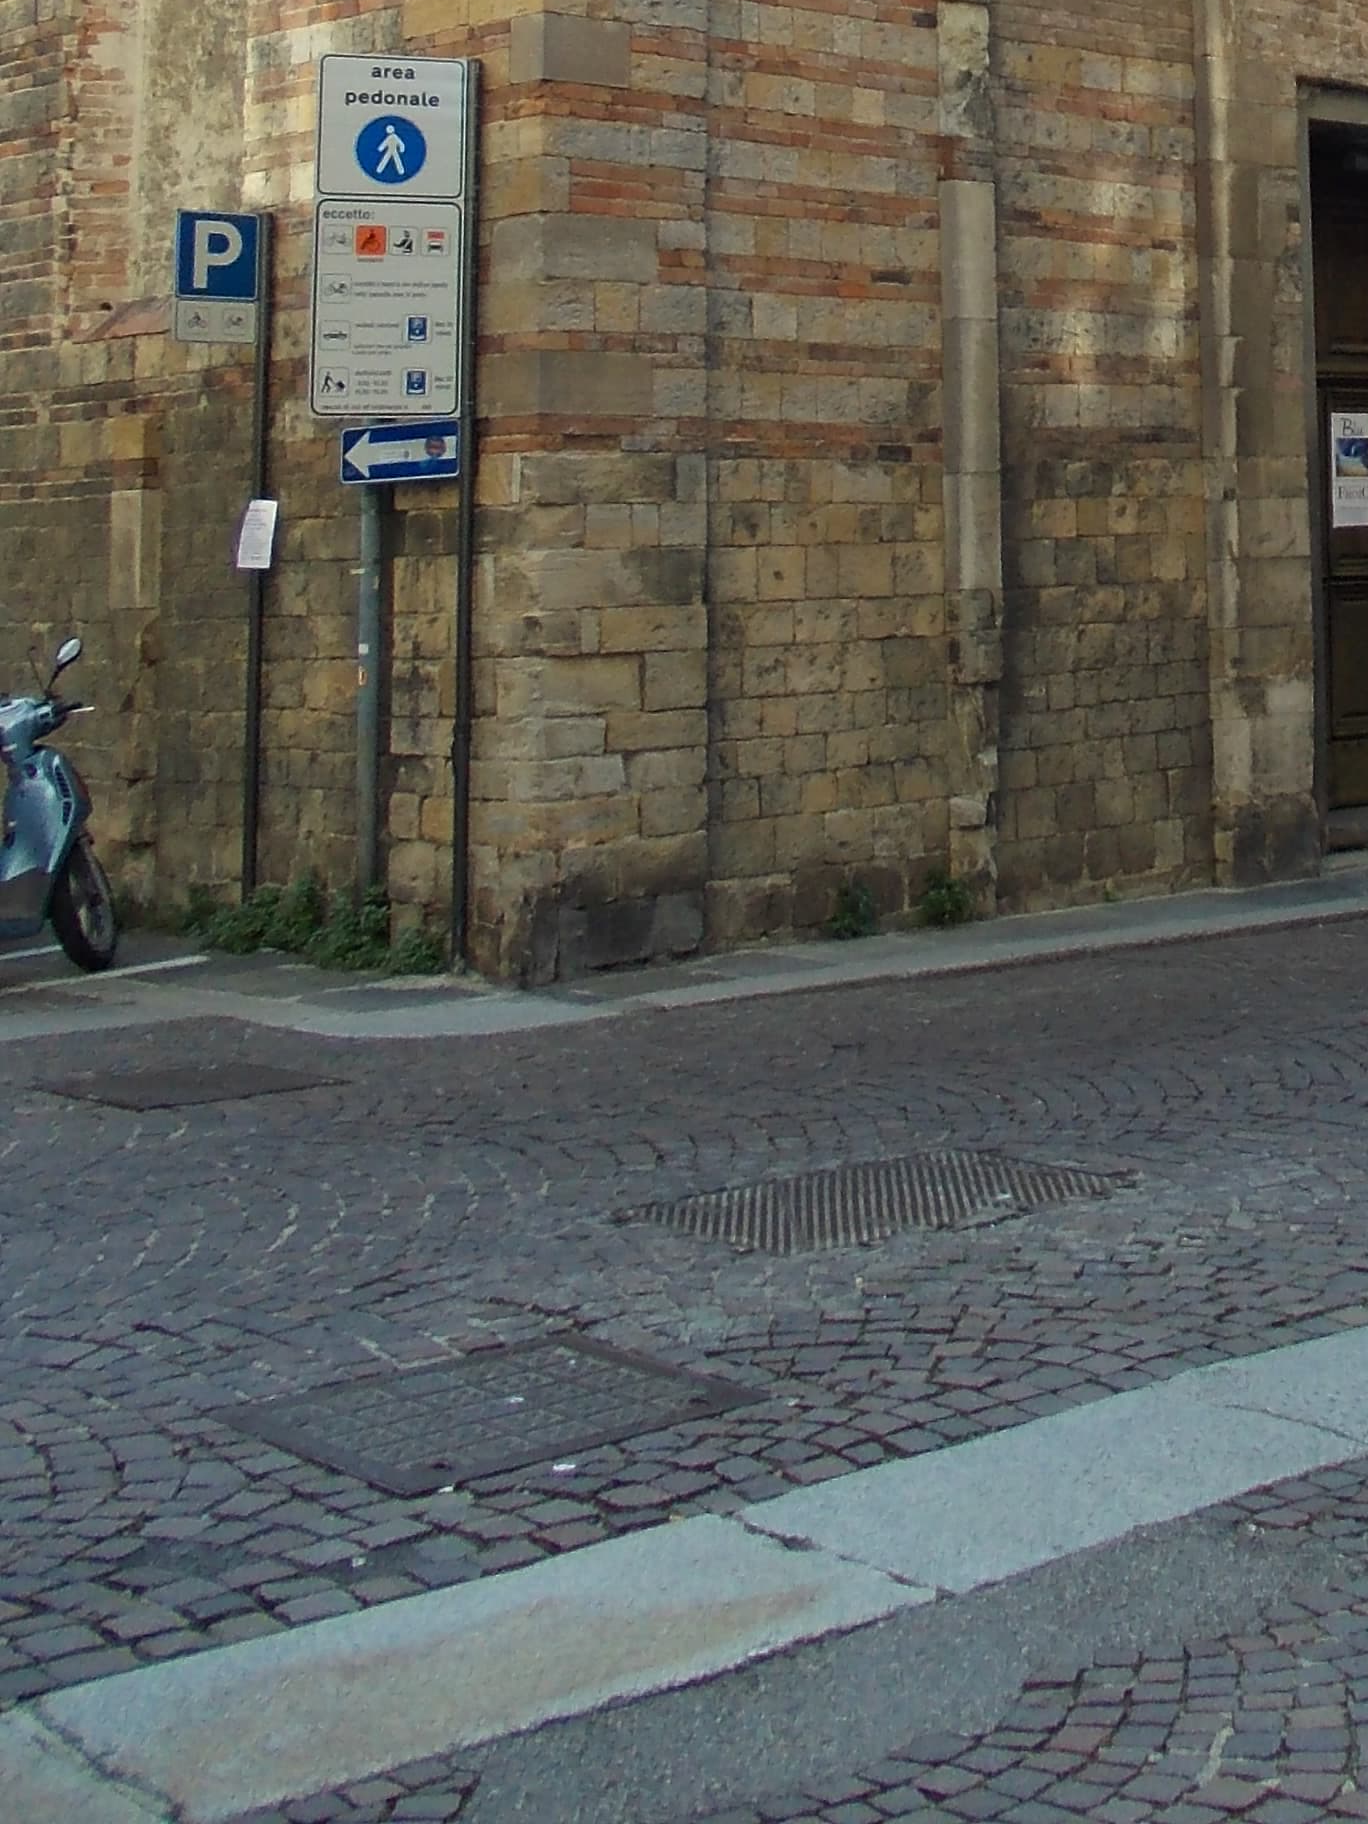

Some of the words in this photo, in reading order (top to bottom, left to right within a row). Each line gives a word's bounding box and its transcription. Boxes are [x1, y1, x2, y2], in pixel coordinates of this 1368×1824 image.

[371, 66, 416, 80] area
[344, 90, 440, 107] pedonale
[322, 209, 376, 220] eccetto:
[193, 219, 243, 289] P
